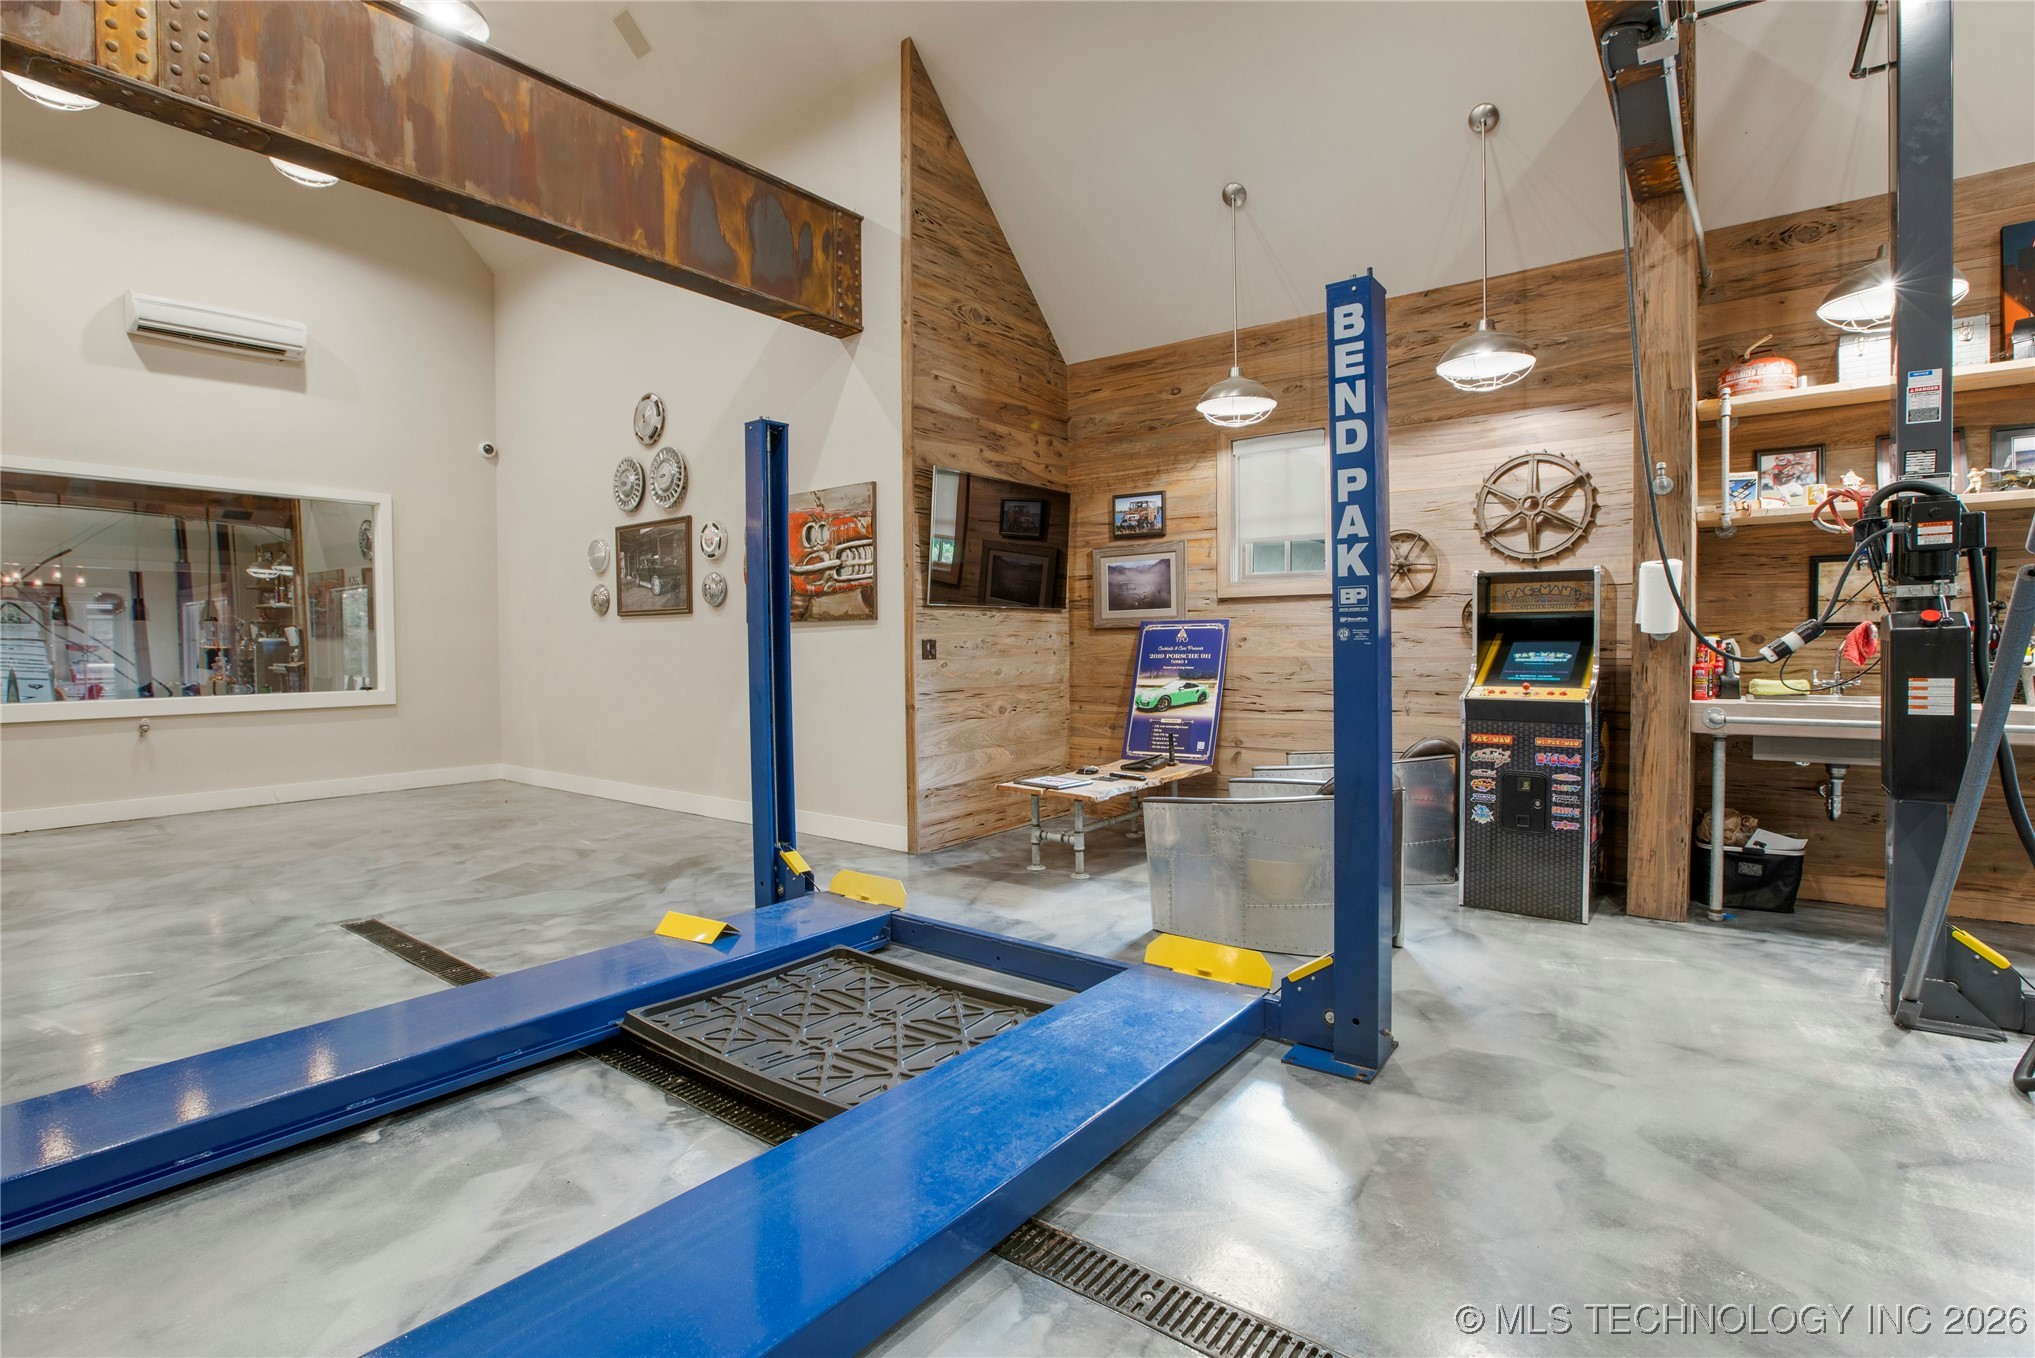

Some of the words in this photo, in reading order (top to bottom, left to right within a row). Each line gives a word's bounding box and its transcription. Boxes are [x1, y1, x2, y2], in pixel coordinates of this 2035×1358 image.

[1340, 588, 1367, 604] BP
[1505, 583, 1582, 601] PAC-MAN'S
[1472, 735, 1511, 743] PAC-MAN
